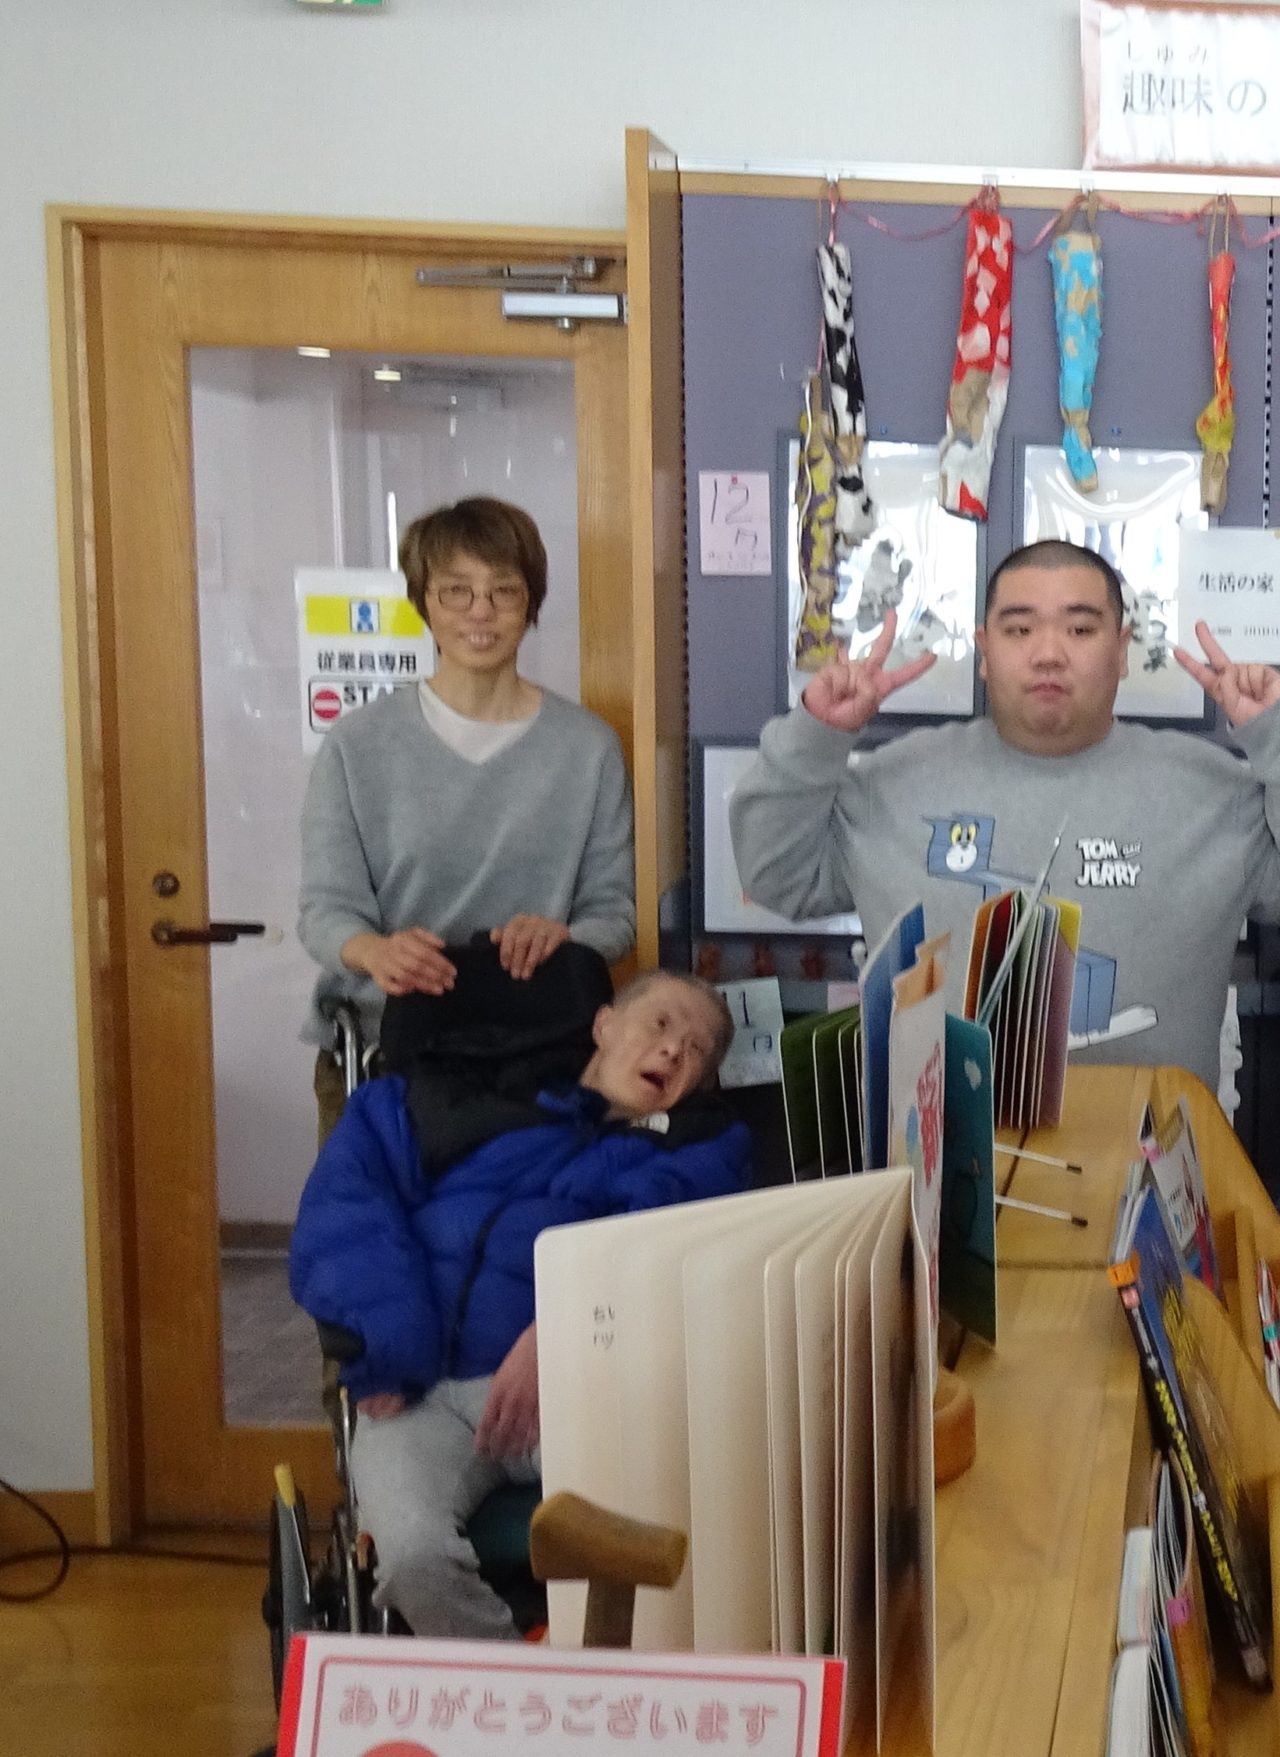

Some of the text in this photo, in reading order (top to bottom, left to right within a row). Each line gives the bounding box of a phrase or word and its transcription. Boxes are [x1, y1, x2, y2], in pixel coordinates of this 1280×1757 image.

[1199, 572, 1274, 594] 生活の家
[318, 650, 417, 674] 従業員専用
[1076, 837, 1120, 861] TOM
[1075, 859, 1142, 888] JERRY
[338, 1683, 780, 1747] ありがとうございます
